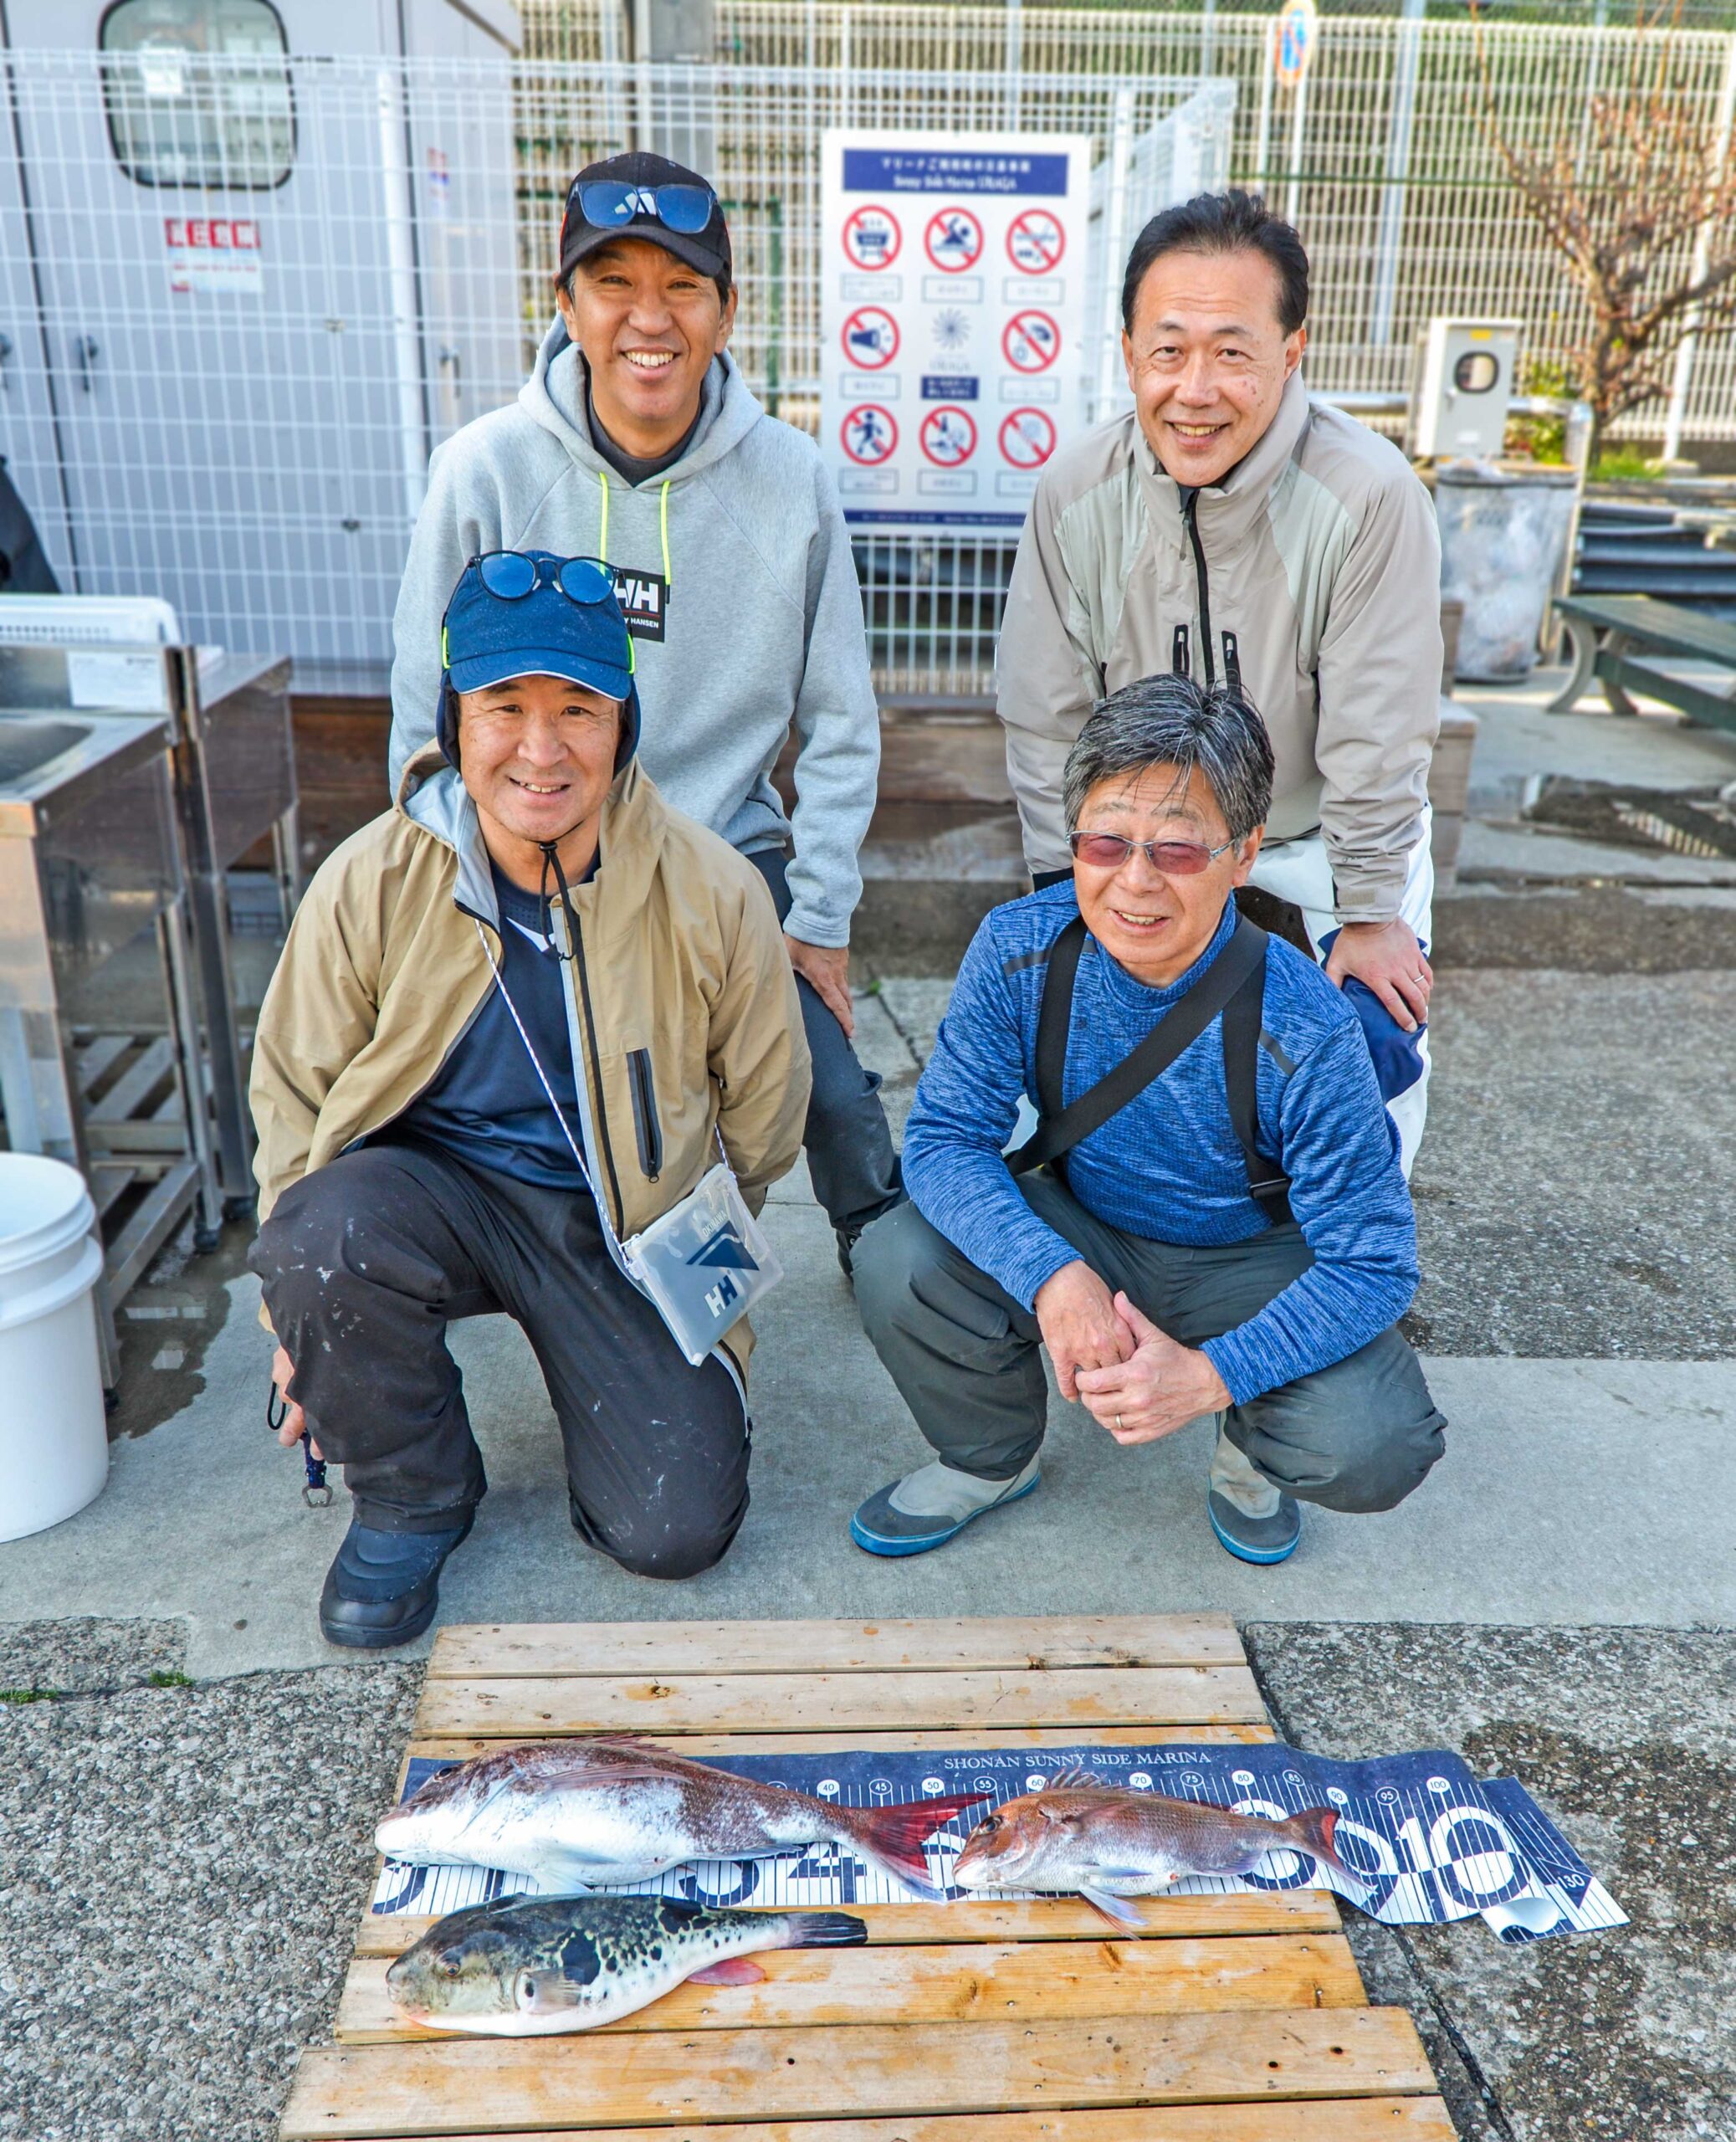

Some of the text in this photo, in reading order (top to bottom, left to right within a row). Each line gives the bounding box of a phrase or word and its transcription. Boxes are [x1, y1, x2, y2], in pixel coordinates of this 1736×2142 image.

[630, 617, 659, 628] HANSEN
[702, 1210, 727, 1238] OKINAWA
[945, 1752, 1212, 1770] SHONAN SUNNY SIDE MARINA
[1558, 1873, 1584, 1890] 130
